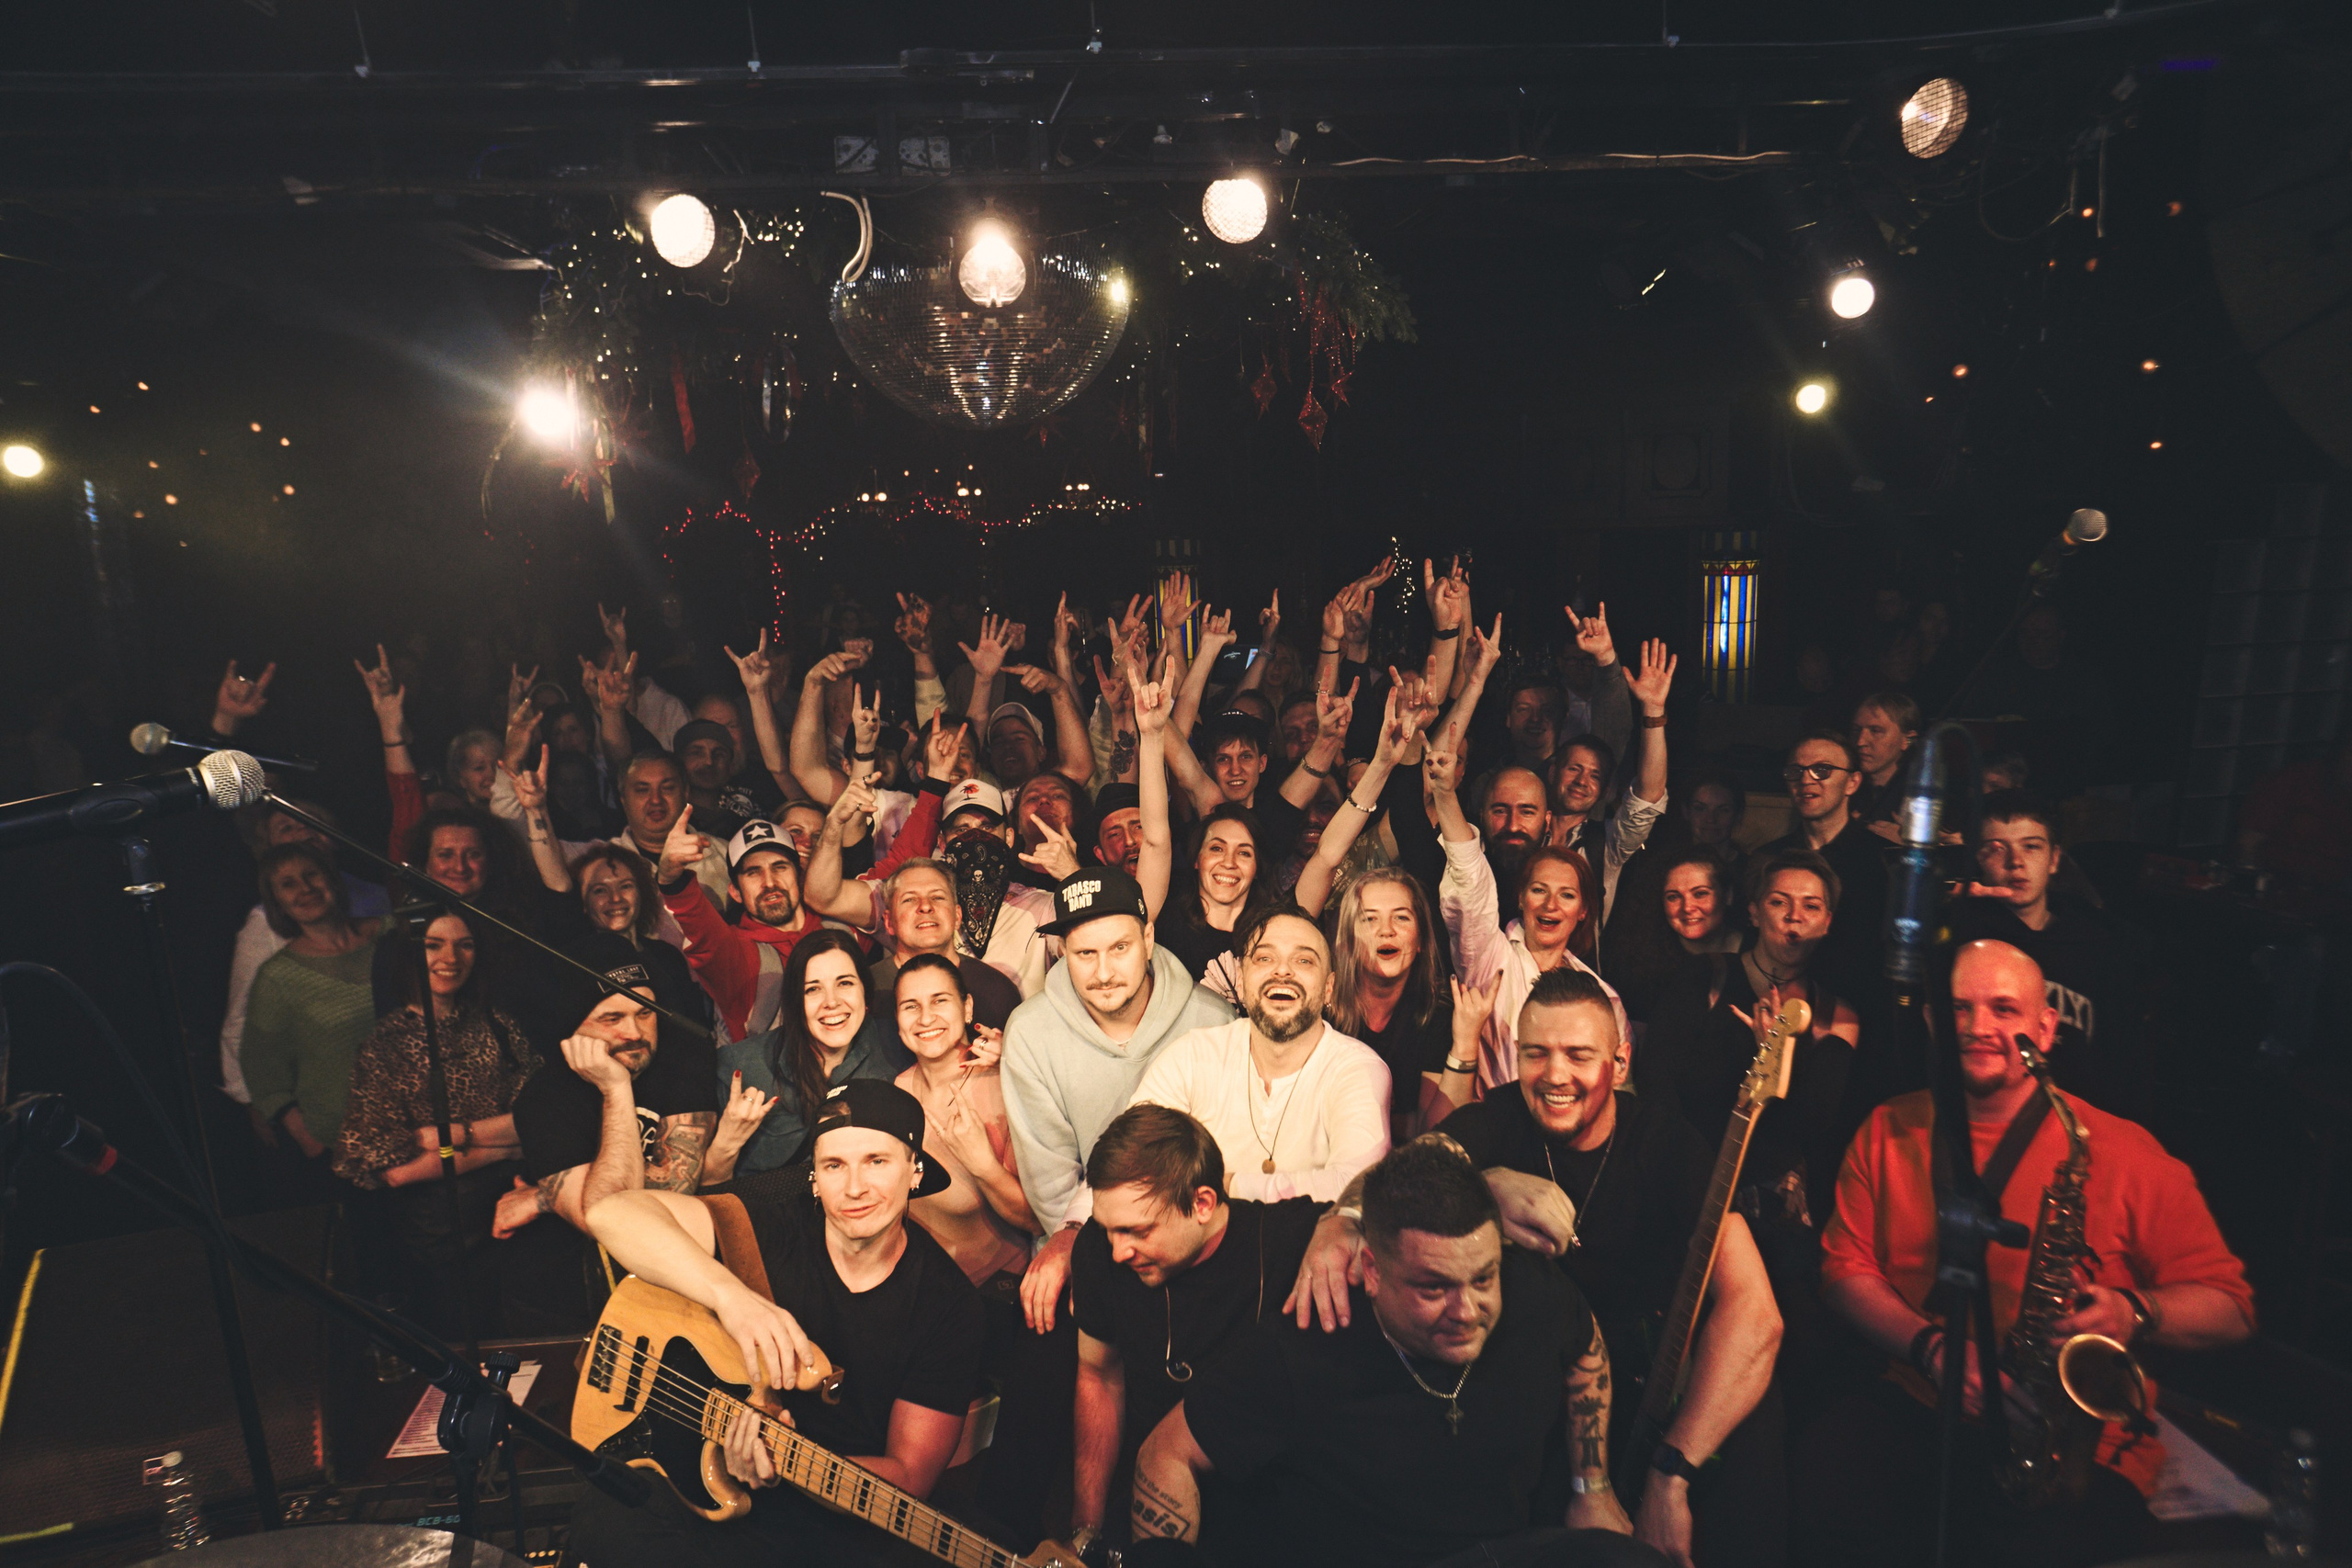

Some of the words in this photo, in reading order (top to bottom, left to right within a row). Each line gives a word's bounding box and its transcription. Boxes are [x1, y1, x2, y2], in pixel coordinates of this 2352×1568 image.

[1062, 880, 1102, 903] TABASCO
[1069, 894, 1092, 912] BAND
[1132, 1499, 1179, 1537] asis
